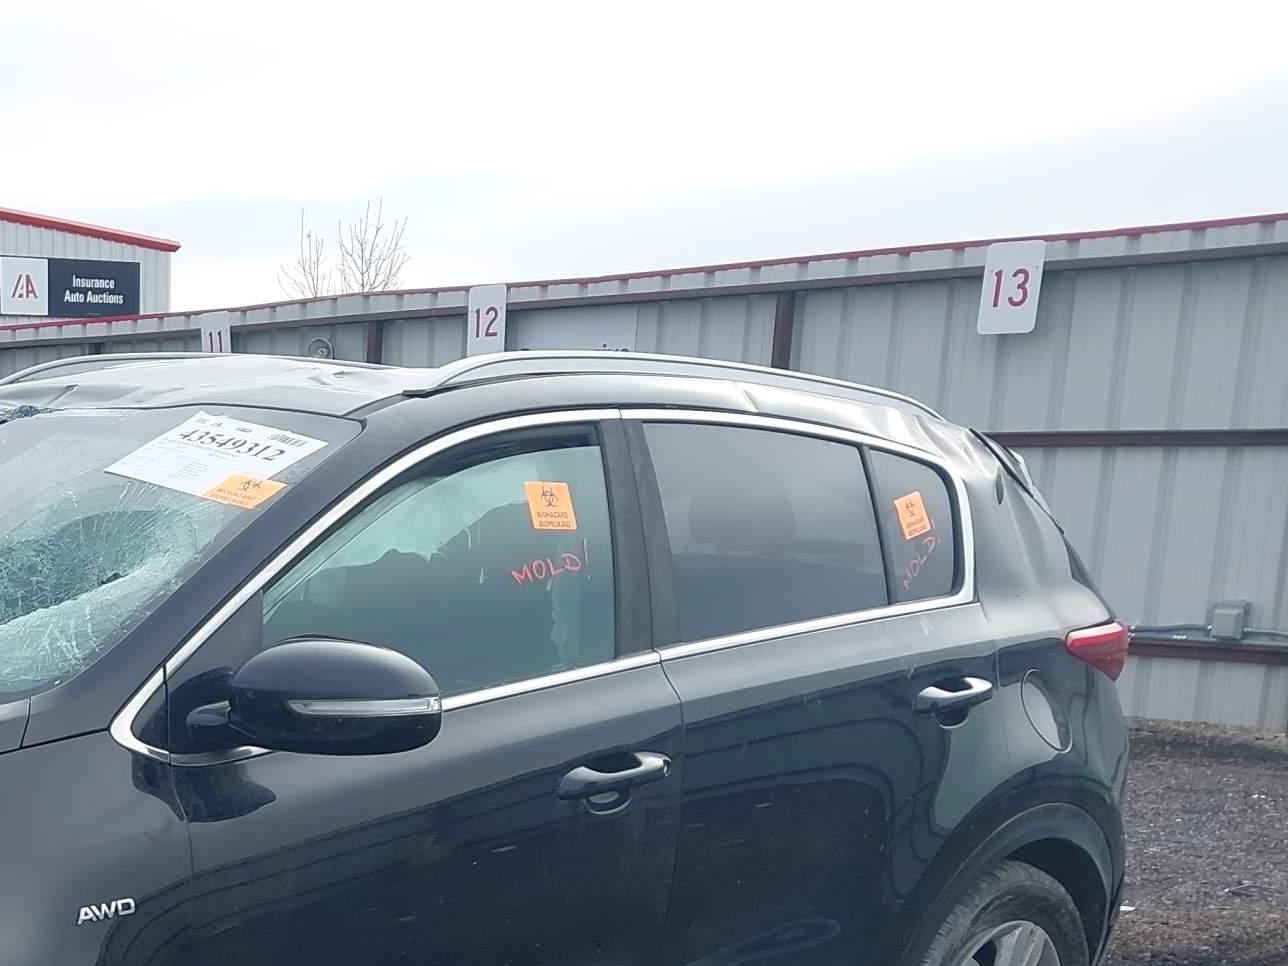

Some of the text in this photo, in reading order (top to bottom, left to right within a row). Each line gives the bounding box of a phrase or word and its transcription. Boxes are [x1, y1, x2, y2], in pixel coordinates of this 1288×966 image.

[72, 275, 116, 289] Insurance
[993, 268, 1030, 308] 13
[64, 290, 124, 305] Auto Auctions
[474, 306, 499, 338] 12
[179, 429, 286, 462] 43549312
[77, 897, 136, 926] AWD
